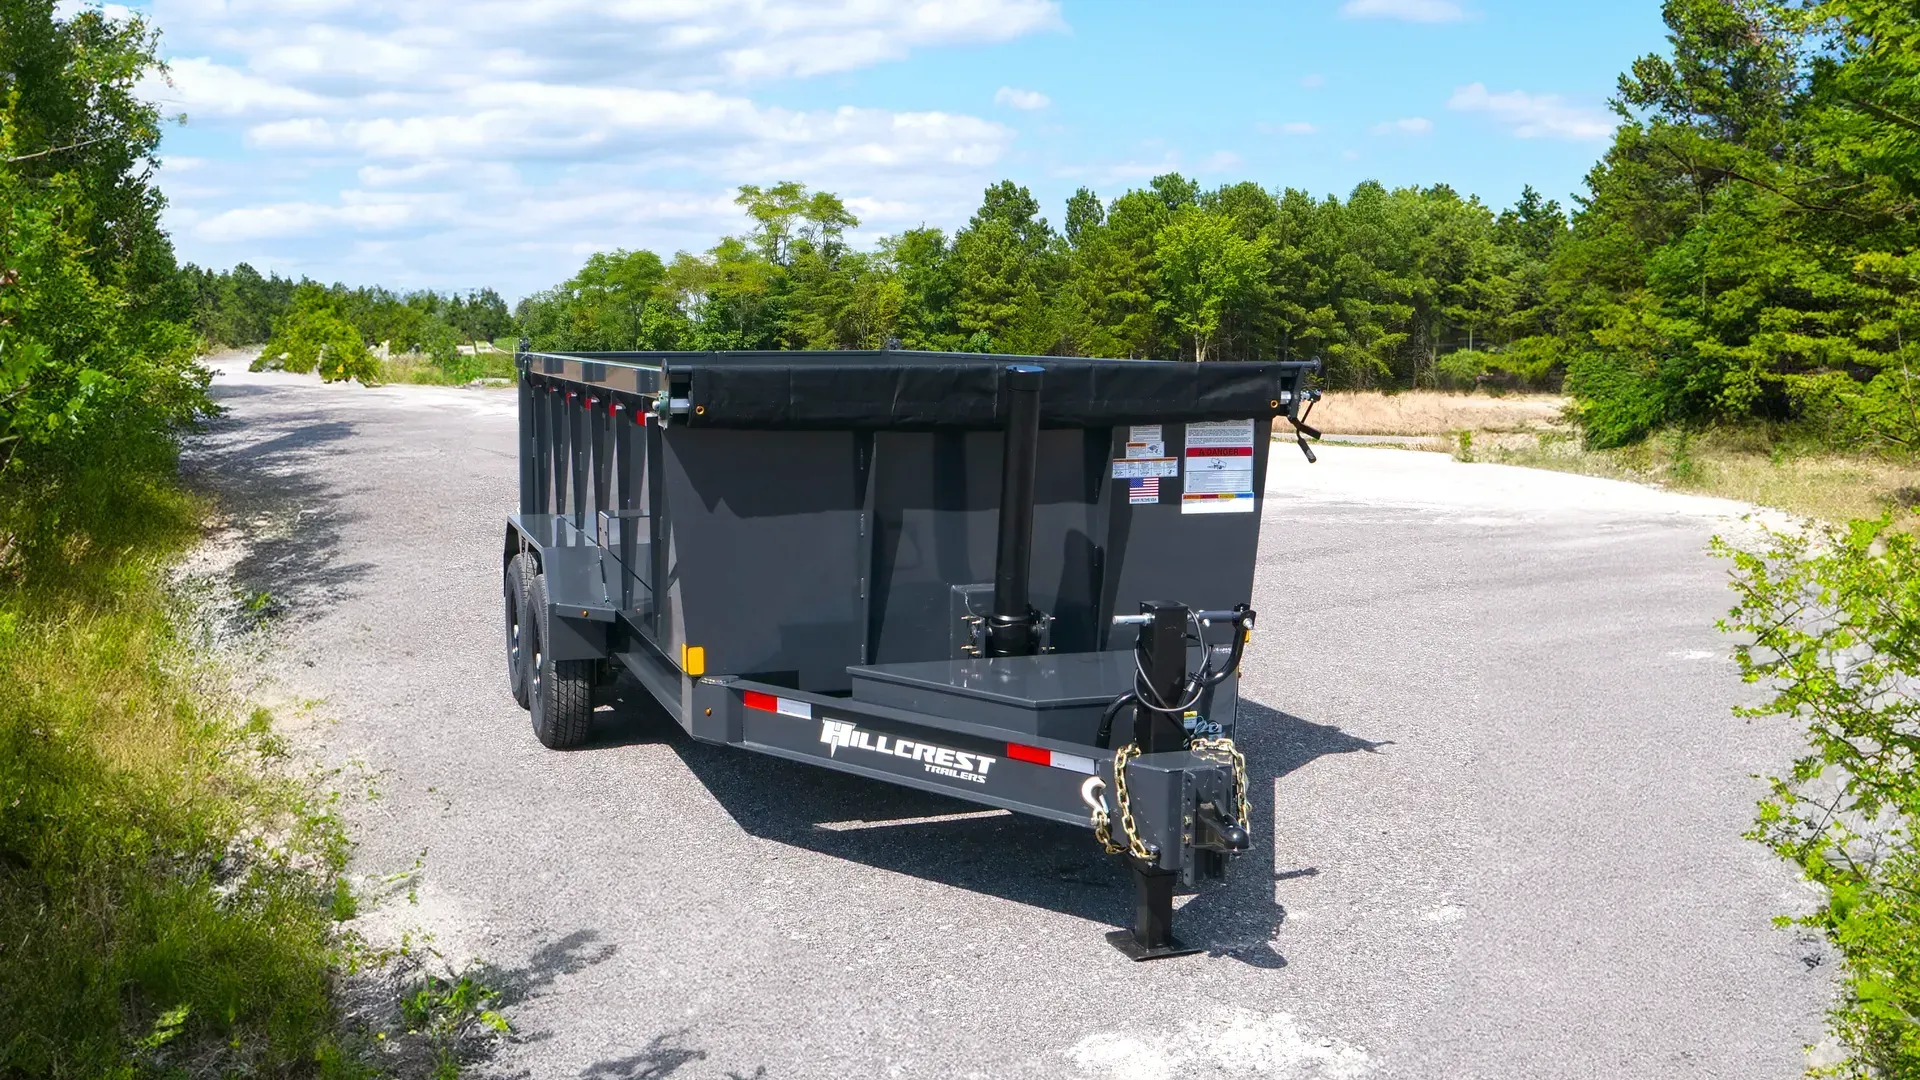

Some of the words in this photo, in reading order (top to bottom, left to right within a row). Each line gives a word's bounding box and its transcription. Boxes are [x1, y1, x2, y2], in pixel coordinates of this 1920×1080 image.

[1206, 448, 1239, 456] DANGER
[820, 717, 996, 774] HILLCREST
[924, 764, 987, 784] TRAILERS
